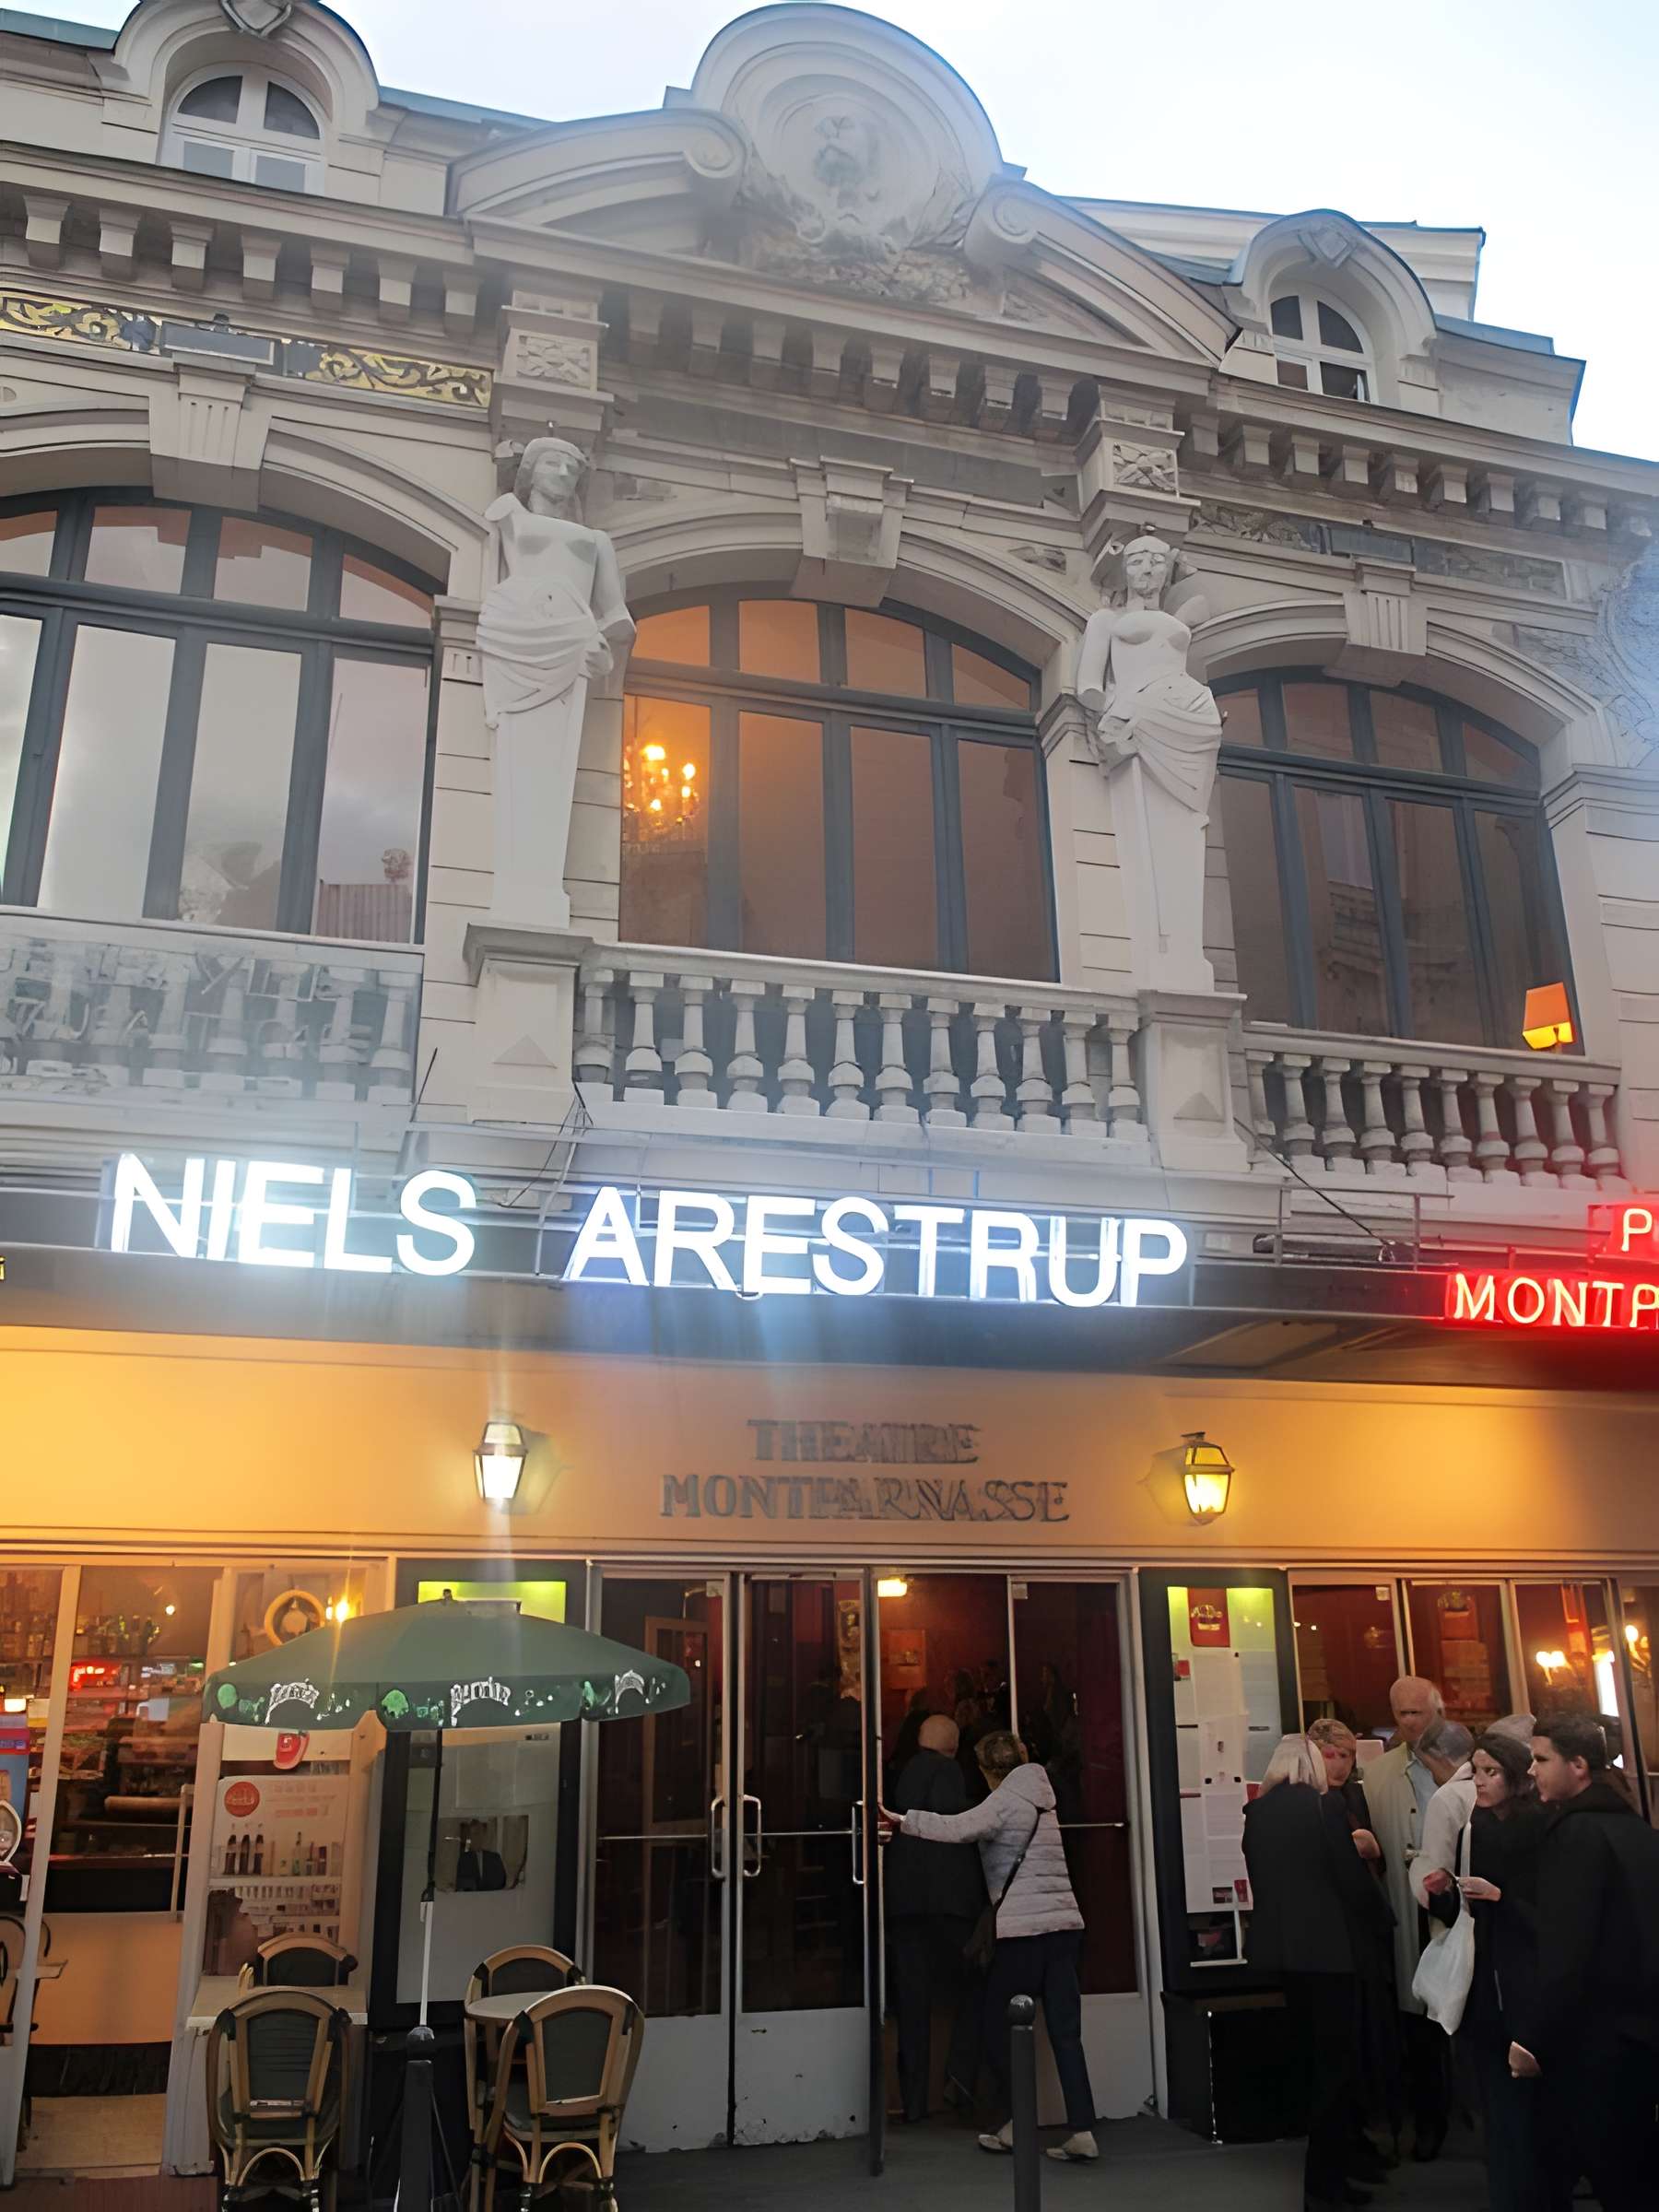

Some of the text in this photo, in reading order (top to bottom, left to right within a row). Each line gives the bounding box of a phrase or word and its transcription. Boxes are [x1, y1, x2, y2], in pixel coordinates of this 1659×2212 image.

[111, 1153, 1189, 1308] NIELS ARESTRUP
[660, 1474, 1070, 1523] MONTPARNASSE
